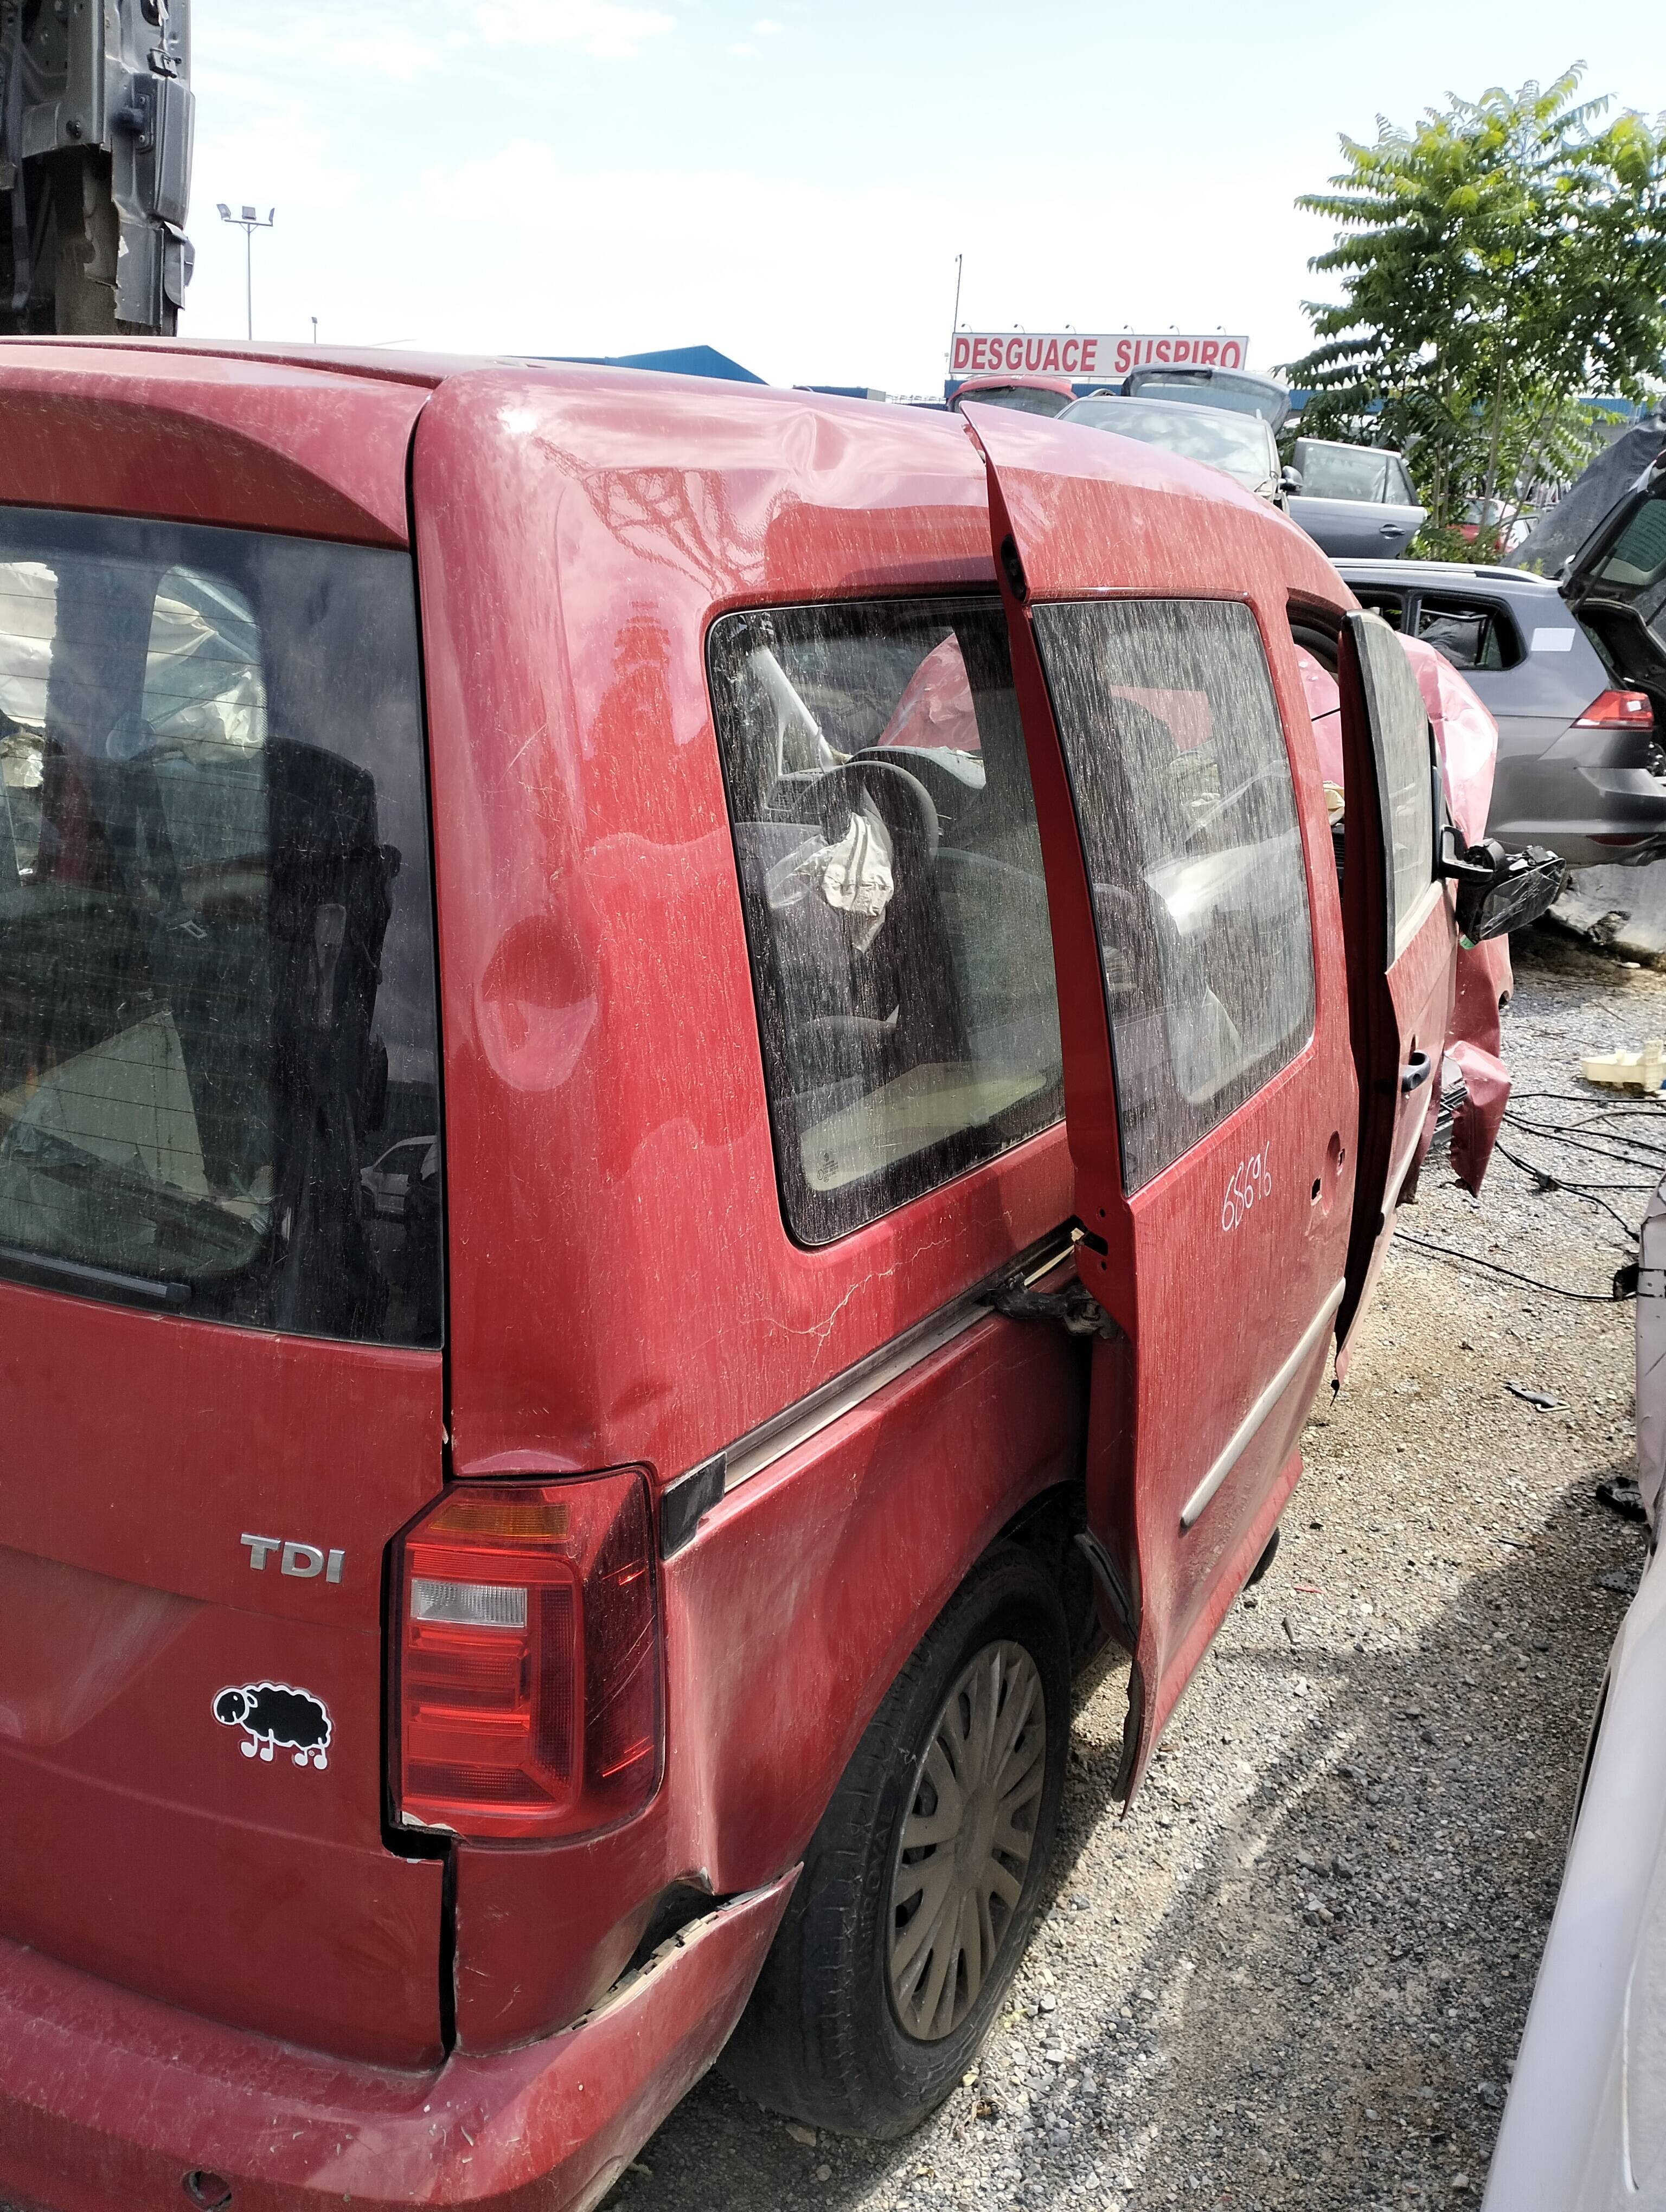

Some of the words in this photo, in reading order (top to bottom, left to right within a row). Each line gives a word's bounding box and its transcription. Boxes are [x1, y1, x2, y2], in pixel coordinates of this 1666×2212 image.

[953, 337, 1098, 372] DESGUACE
[1114, 339, 1241, 373] SUSPIRO
[240, 1533, 345, 1584] TDI
